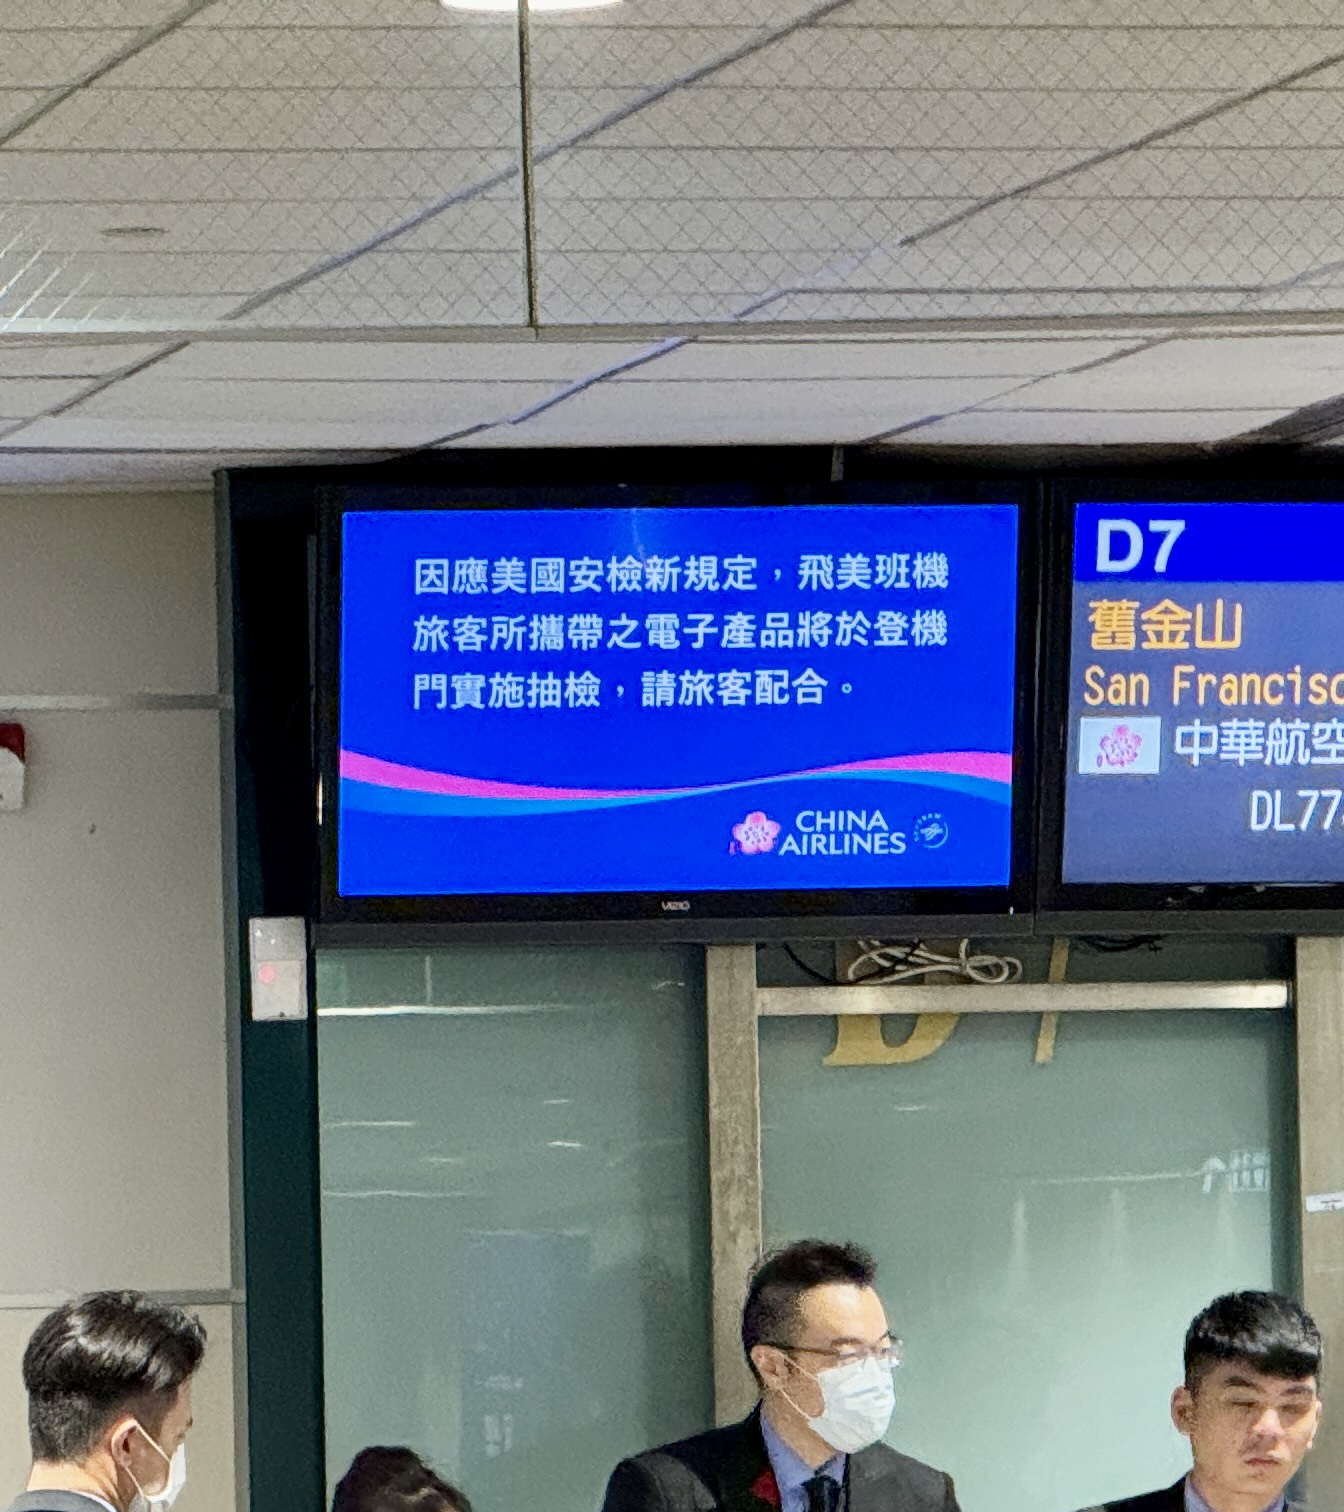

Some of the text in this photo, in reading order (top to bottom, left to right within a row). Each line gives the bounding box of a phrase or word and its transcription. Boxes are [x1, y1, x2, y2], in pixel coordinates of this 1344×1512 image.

[1096, 519, 1186, 573] D7
[415, 551, 949, 595] 因應美國安檢新規定，飛美班機
[413, 609, 948, 652] 旅客所攜帶之電子產品將於登機
[1088, 598, 1243, 650] 舊金山
[413, 667, 852, 710] 門實施抽檢，請旅客配合。
[1083, 665, 1150, 706] San
[795, 809, 889, 833] CHINA
[777, 832, 907, 856] AIRLINES
